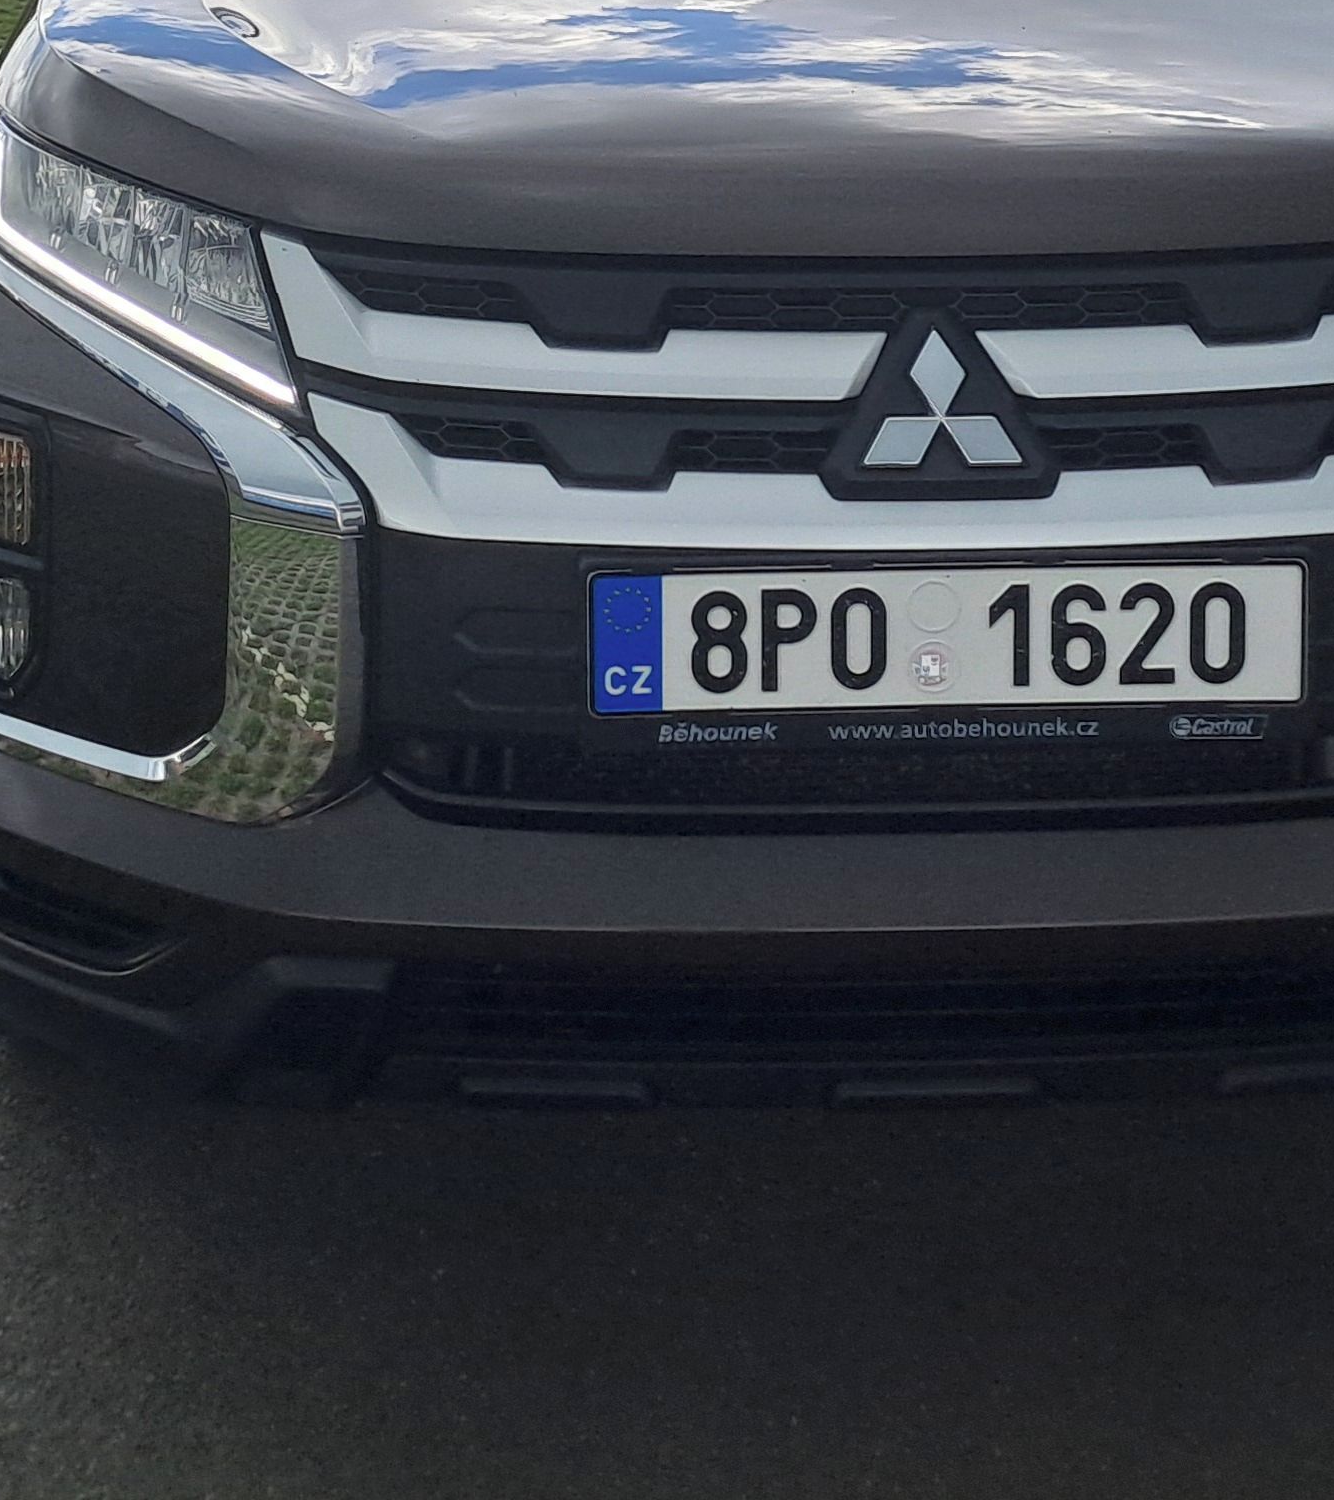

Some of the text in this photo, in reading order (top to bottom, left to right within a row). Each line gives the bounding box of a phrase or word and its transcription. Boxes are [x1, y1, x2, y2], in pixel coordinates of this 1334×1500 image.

[690, 581, 1246, 694] 8P0 1620
[604, 664, 654, 696] CZ
[658, 721, 779, 744] Běhounek
[827, 716, 1100, 741] www.autobehounek.cz
[1192, 718, 1254, 735] Castrol
